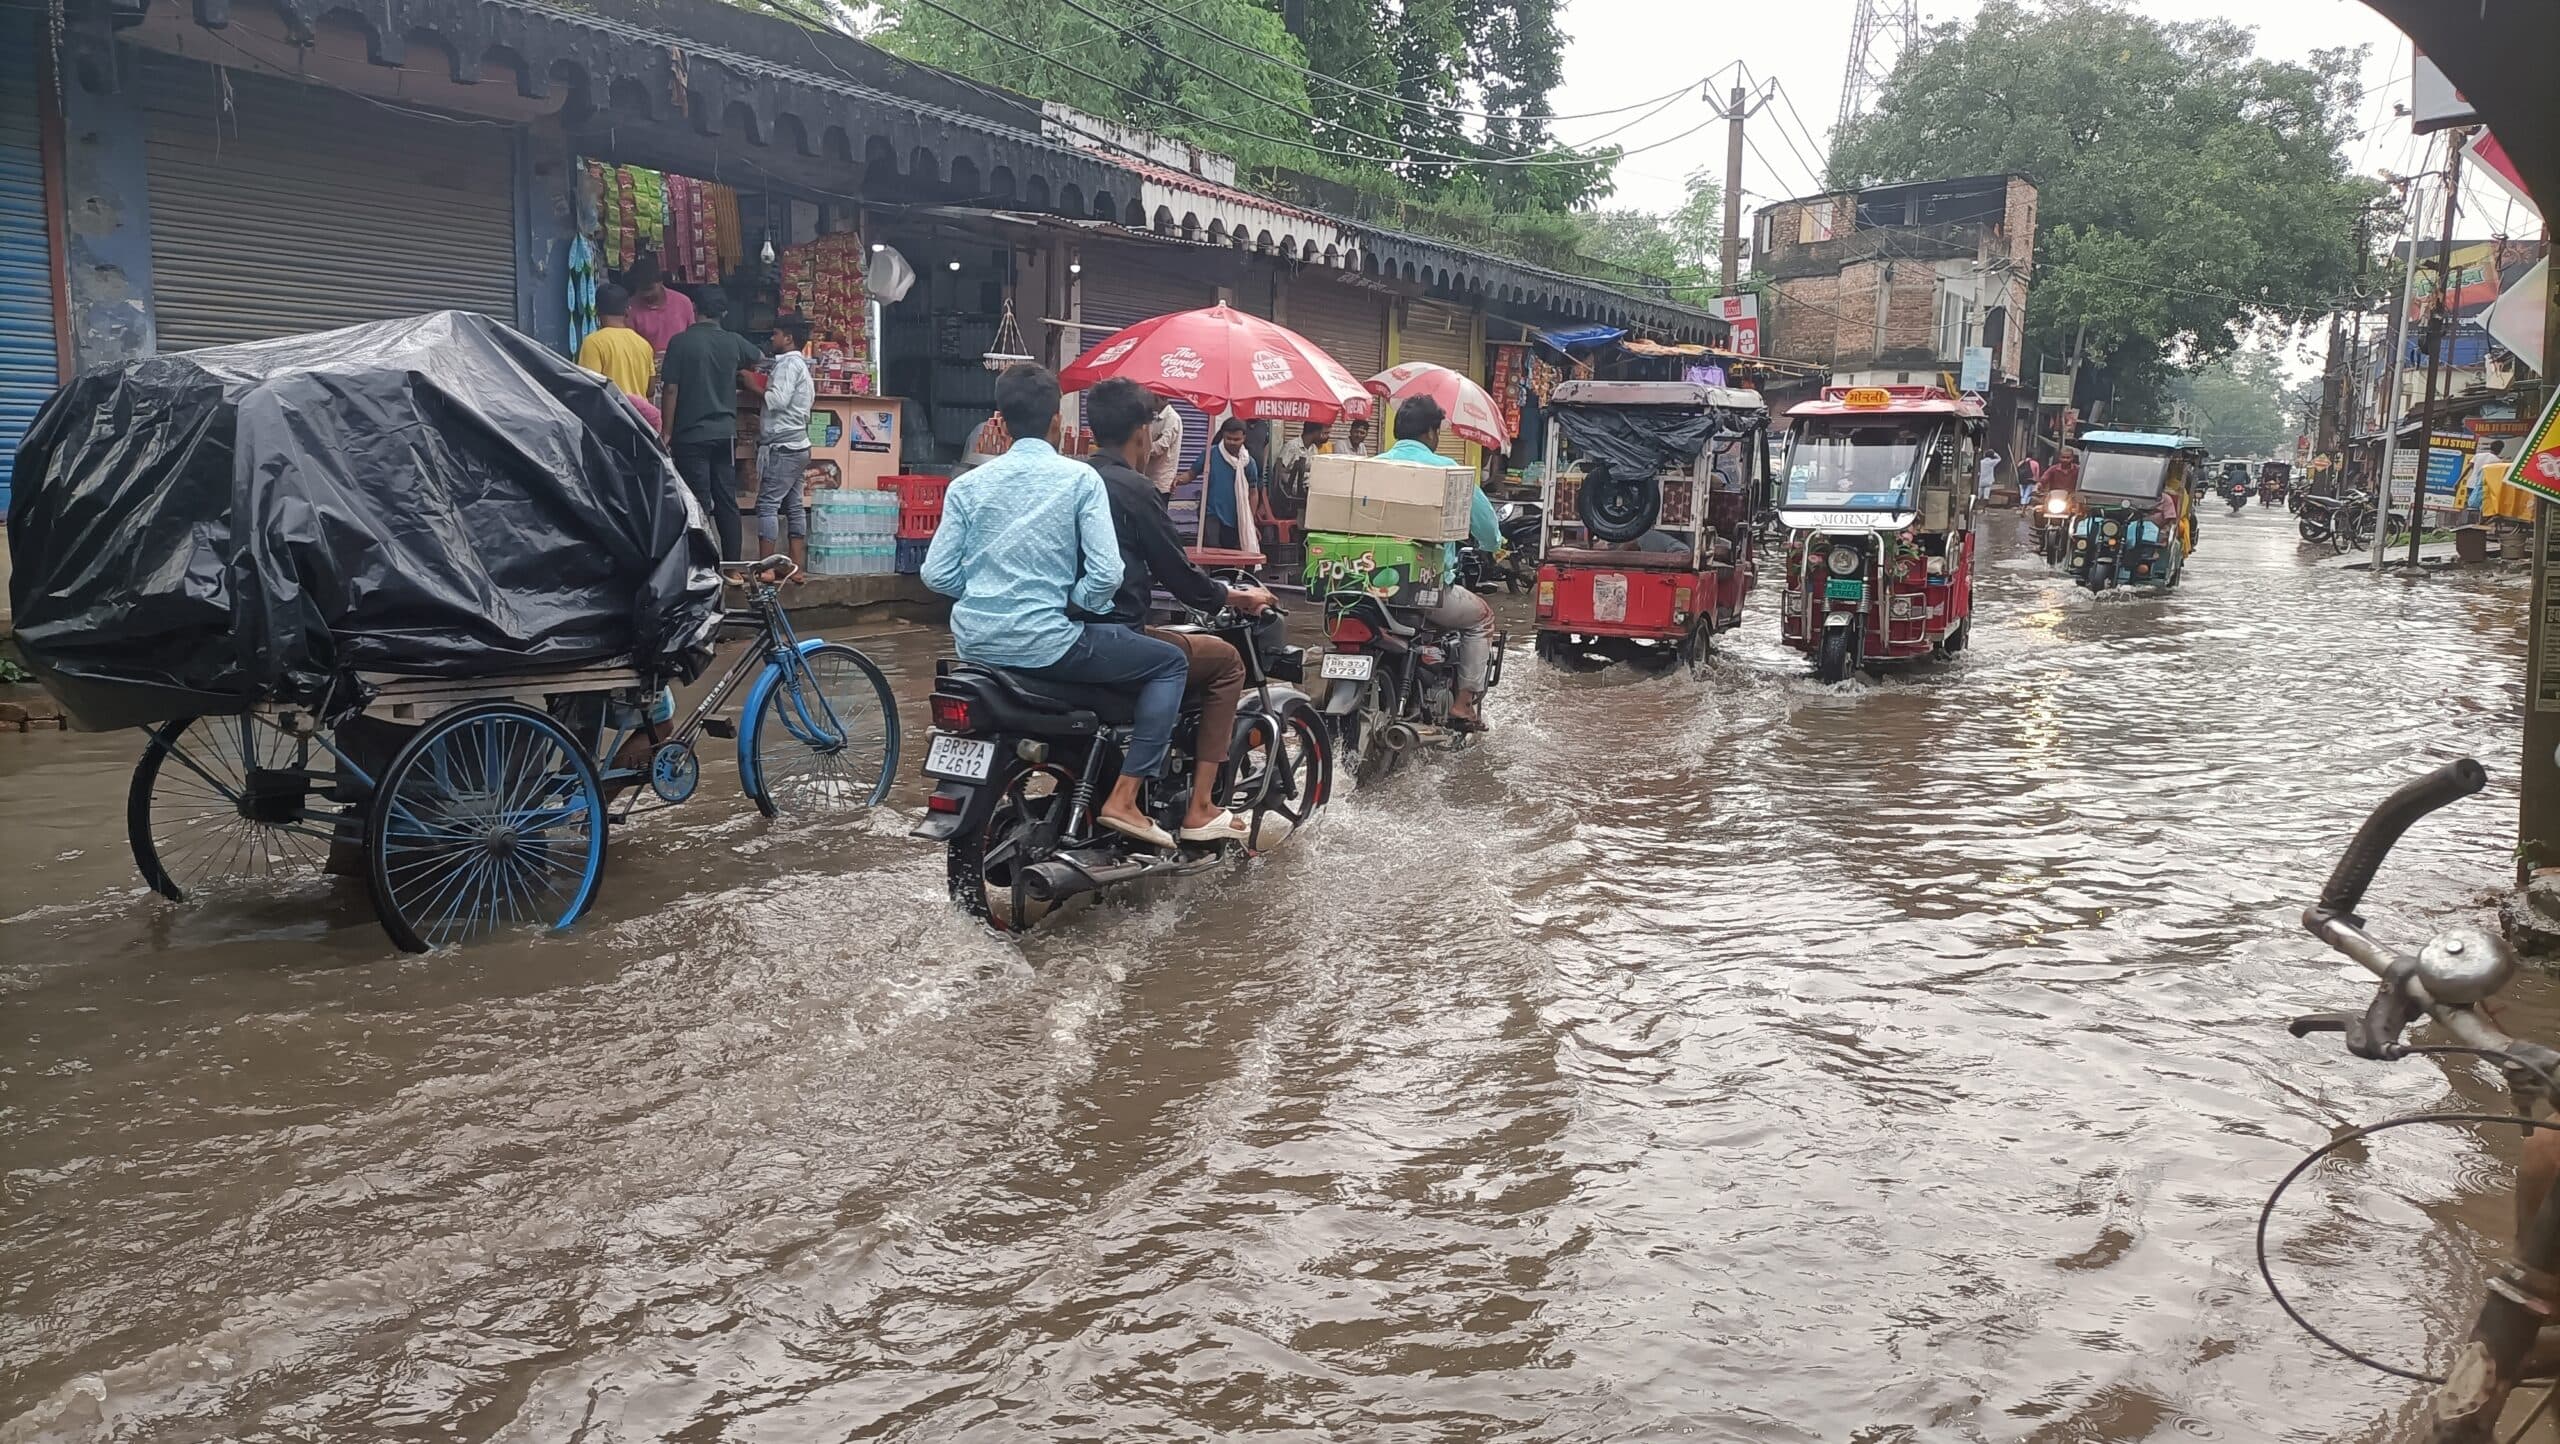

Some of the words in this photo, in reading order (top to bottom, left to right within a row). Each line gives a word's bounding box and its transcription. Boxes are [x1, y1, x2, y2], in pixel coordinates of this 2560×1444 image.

[1173, 347, 1197, 359] The
[1160, 354, 1205, 371] Family
[1262, 361, 1280, 370] BIG
[1161, 366, 1199, 380] Store
[1258, 371, 1287, 382] MART
[1255, 400, 1310, 418] MENSWEAR
[2450, 438, 2477, 450] STORE
[941, 738, 985, 760] BR37A
[937, 754, 982, 776] F4612
